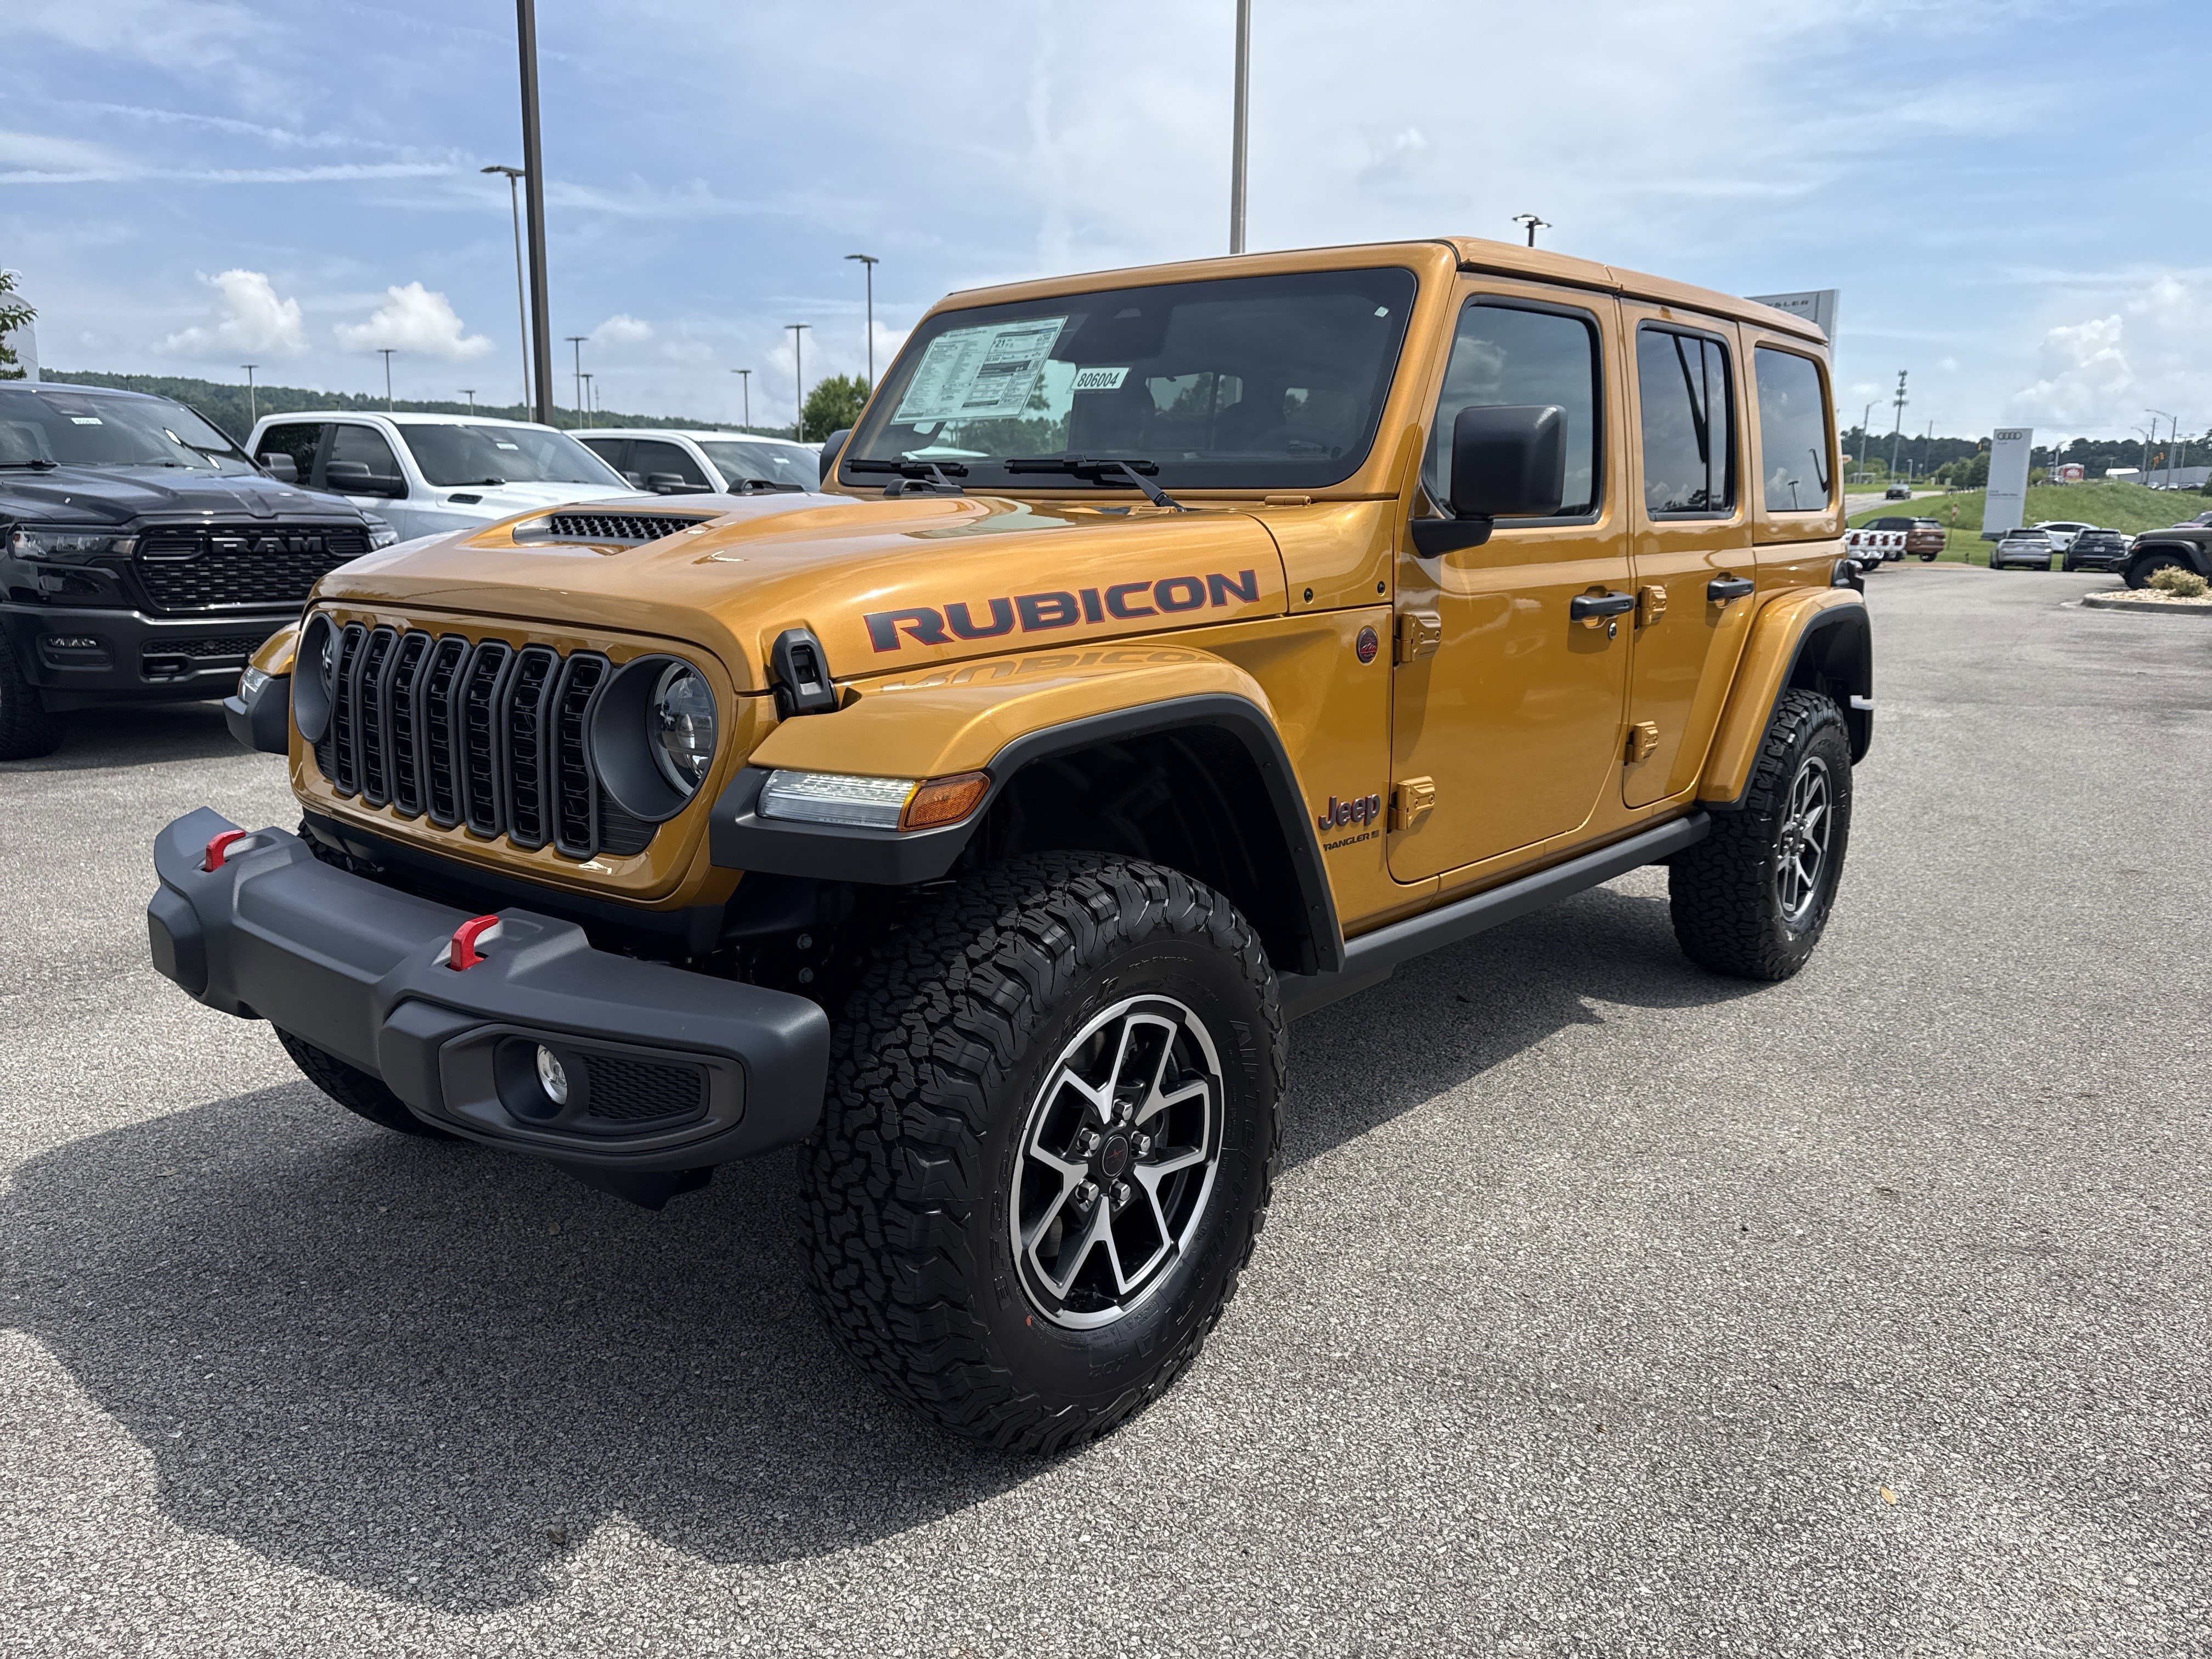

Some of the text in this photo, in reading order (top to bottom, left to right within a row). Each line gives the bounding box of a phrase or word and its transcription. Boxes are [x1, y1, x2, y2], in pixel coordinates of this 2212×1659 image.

[1077, 373, 1120, 387] 806004
[212, 537, 323, 553] RAM
[864, 569, 1260, 653] RUBICON
[1318, 794, 1381, 831] Jeep
